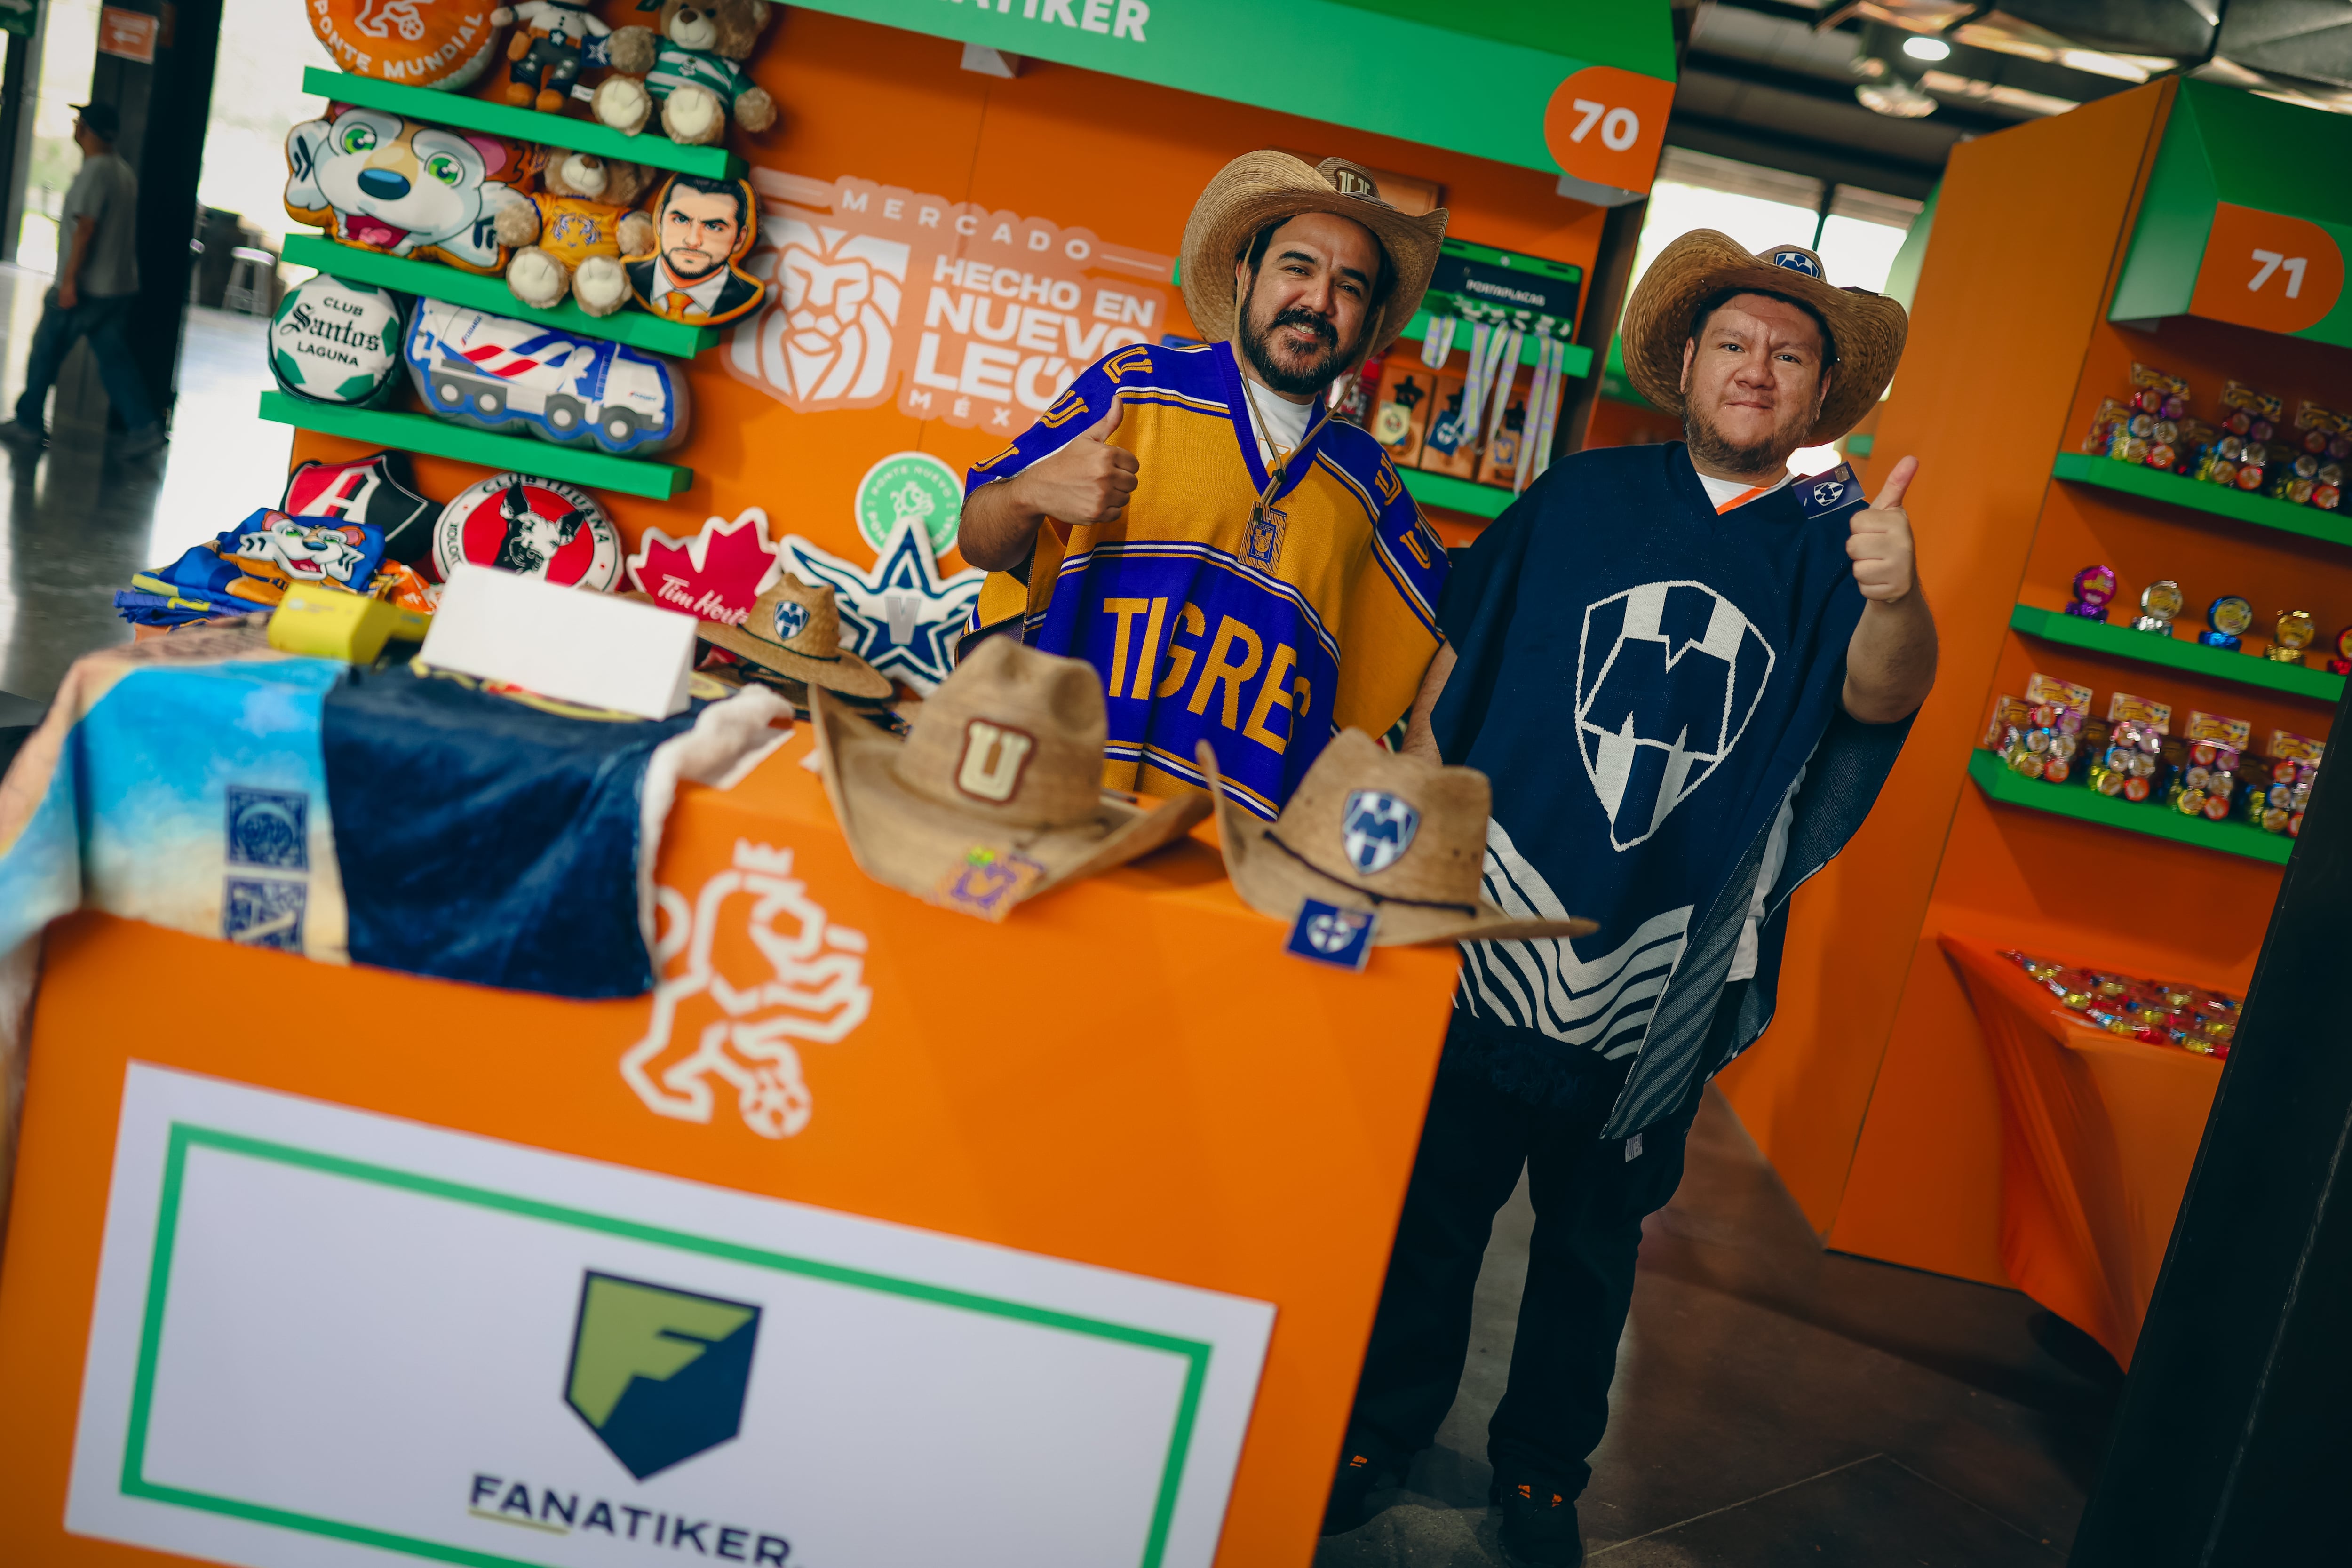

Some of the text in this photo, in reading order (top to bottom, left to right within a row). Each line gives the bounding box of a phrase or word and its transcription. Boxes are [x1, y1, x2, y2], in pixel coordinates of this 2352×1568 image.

[314, 0, 484, 79] PONTE MUNDIAL
[1569, 98, 1640, 152] 70
[842, 189, 1091, 260] MERCADO
[933, 255, 1156, 328] HECHO EN
[2247, 248, 2308, 299] 71
[280, 303, 380, 351] Santos
[323, 296, 364, 316] CLUB
[296, 341, 359, 367] LAGUNA
[914, 332, 1074, 412] LEÓ
[658, 573, 695, 609] Tim
[959, 721, 1032, 802] U
[469, 1472, 792, 1568] FANATIKER
